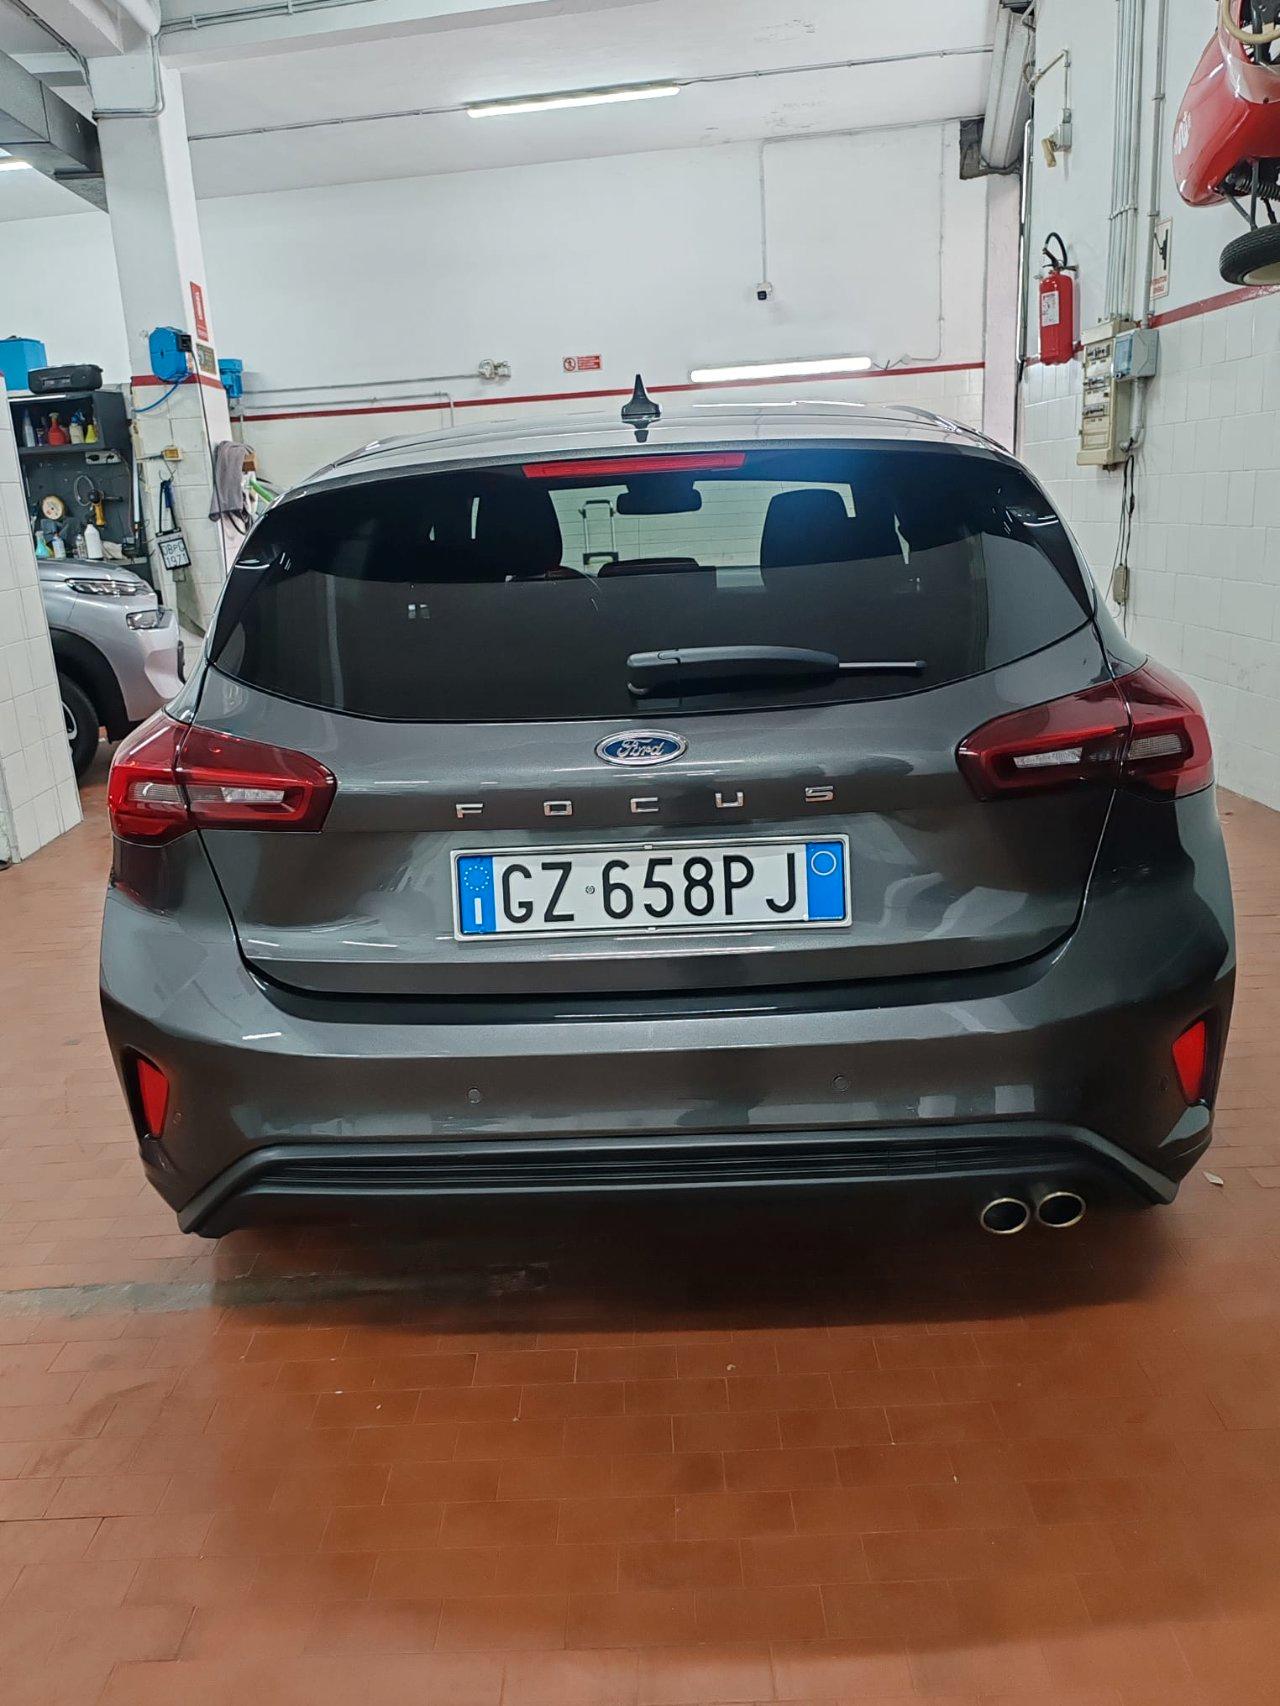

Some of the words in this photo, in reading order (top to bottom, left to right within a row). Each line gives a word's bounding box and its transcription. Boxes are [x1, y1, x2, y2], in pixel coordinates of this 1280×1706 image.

[616, 738, 666, 759] Ford
[455, 785, 834, 818] FOCUS
[501, 861, 575, 923] GZ
[601, 852, 797, 920] 658PJ
